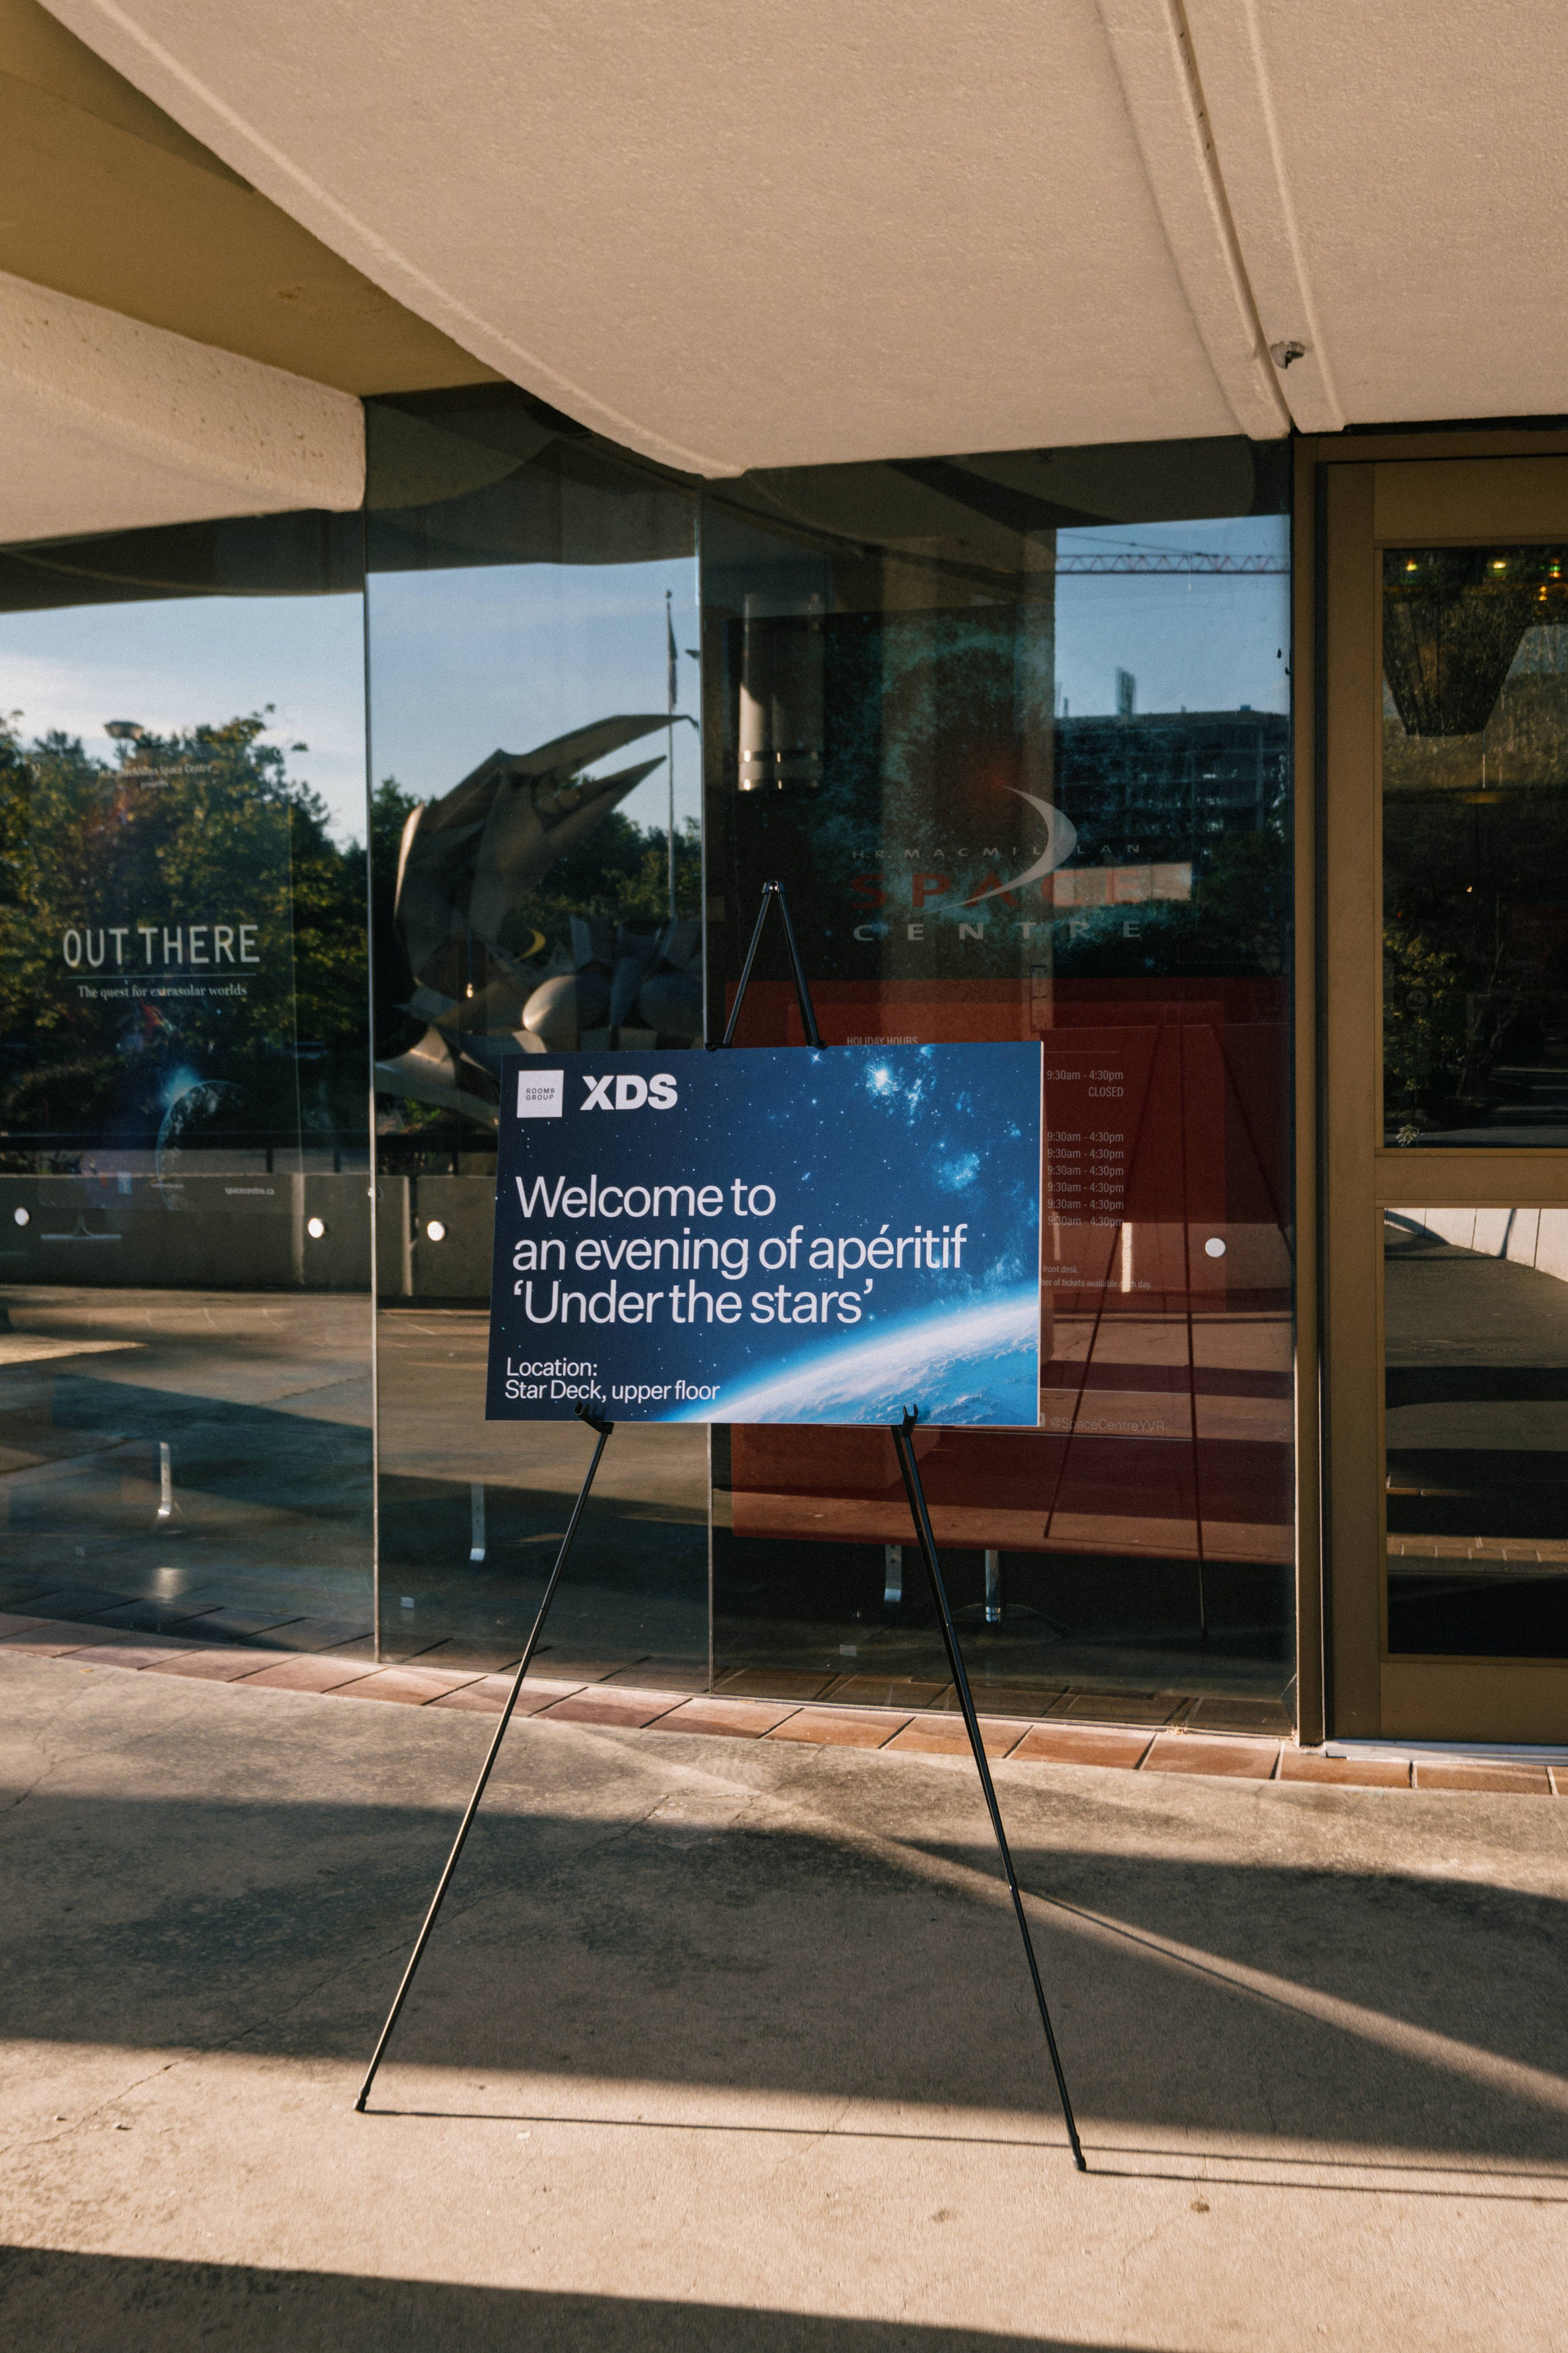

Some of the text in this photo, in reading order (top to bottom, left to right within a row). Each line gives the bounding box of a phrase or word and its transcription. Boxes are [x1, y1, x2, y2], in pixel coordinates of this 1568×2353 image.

[184, 764, 212, 774] Centre
[904, 844, 1140, 858] MACMILLAN
[851, 869, 1140, 909] SPACE
[853, 921, 1140, 942] CENTRE
[63, 924, 260, 967] OUT THERE
[77, 983, 248, 1000] The quest for extrasolar worlds
[846, 1035, 918, 1046] HOLIDAY HOURS
[1047, 1070, 1080, 1080] 9:30am
[1088, 1070, 1123, 1082] 4:30pm
[580, 1073, 678, 1111] XDS
[1088, 1087, 1123, 1097] CLOSED
[1047, 1131, 1081, 1142] 9:30am
[1089, 1132, 1124, 1144] 4:30pm
[1047, 1148, 1081, 1158] 9:30am
[1089, 1149, 1124, 1161] 4:30pm
[1047, 1165, 1081, 1176] 9:30am
[1089, 1166, 1124, 1178] 4:30pm
[1047, 1182, 1081, 1192] 9:30am
[1089, 1182, 1124, 1195] 4:30pm
[515, 1174, 776, 1218] Welcome to
[1047, 1199, 1081, 1209] 9:30am
[1089, 1199, 1124, 1212] 4:30pm
[513, 1223, 968, 1280] an evening of apéritif
[1042, 1265, 1079, 1274] front desk.
[1054, 1278, 1061, 1286] of
[1061, 1278, 1085, 1288] tickets
[1086, 1278, 1118, 1288] available
[1137, 1280, 1152, 1290] day.
[669, 1278, 742, 1323] the
[507, 1357, 598, 1377] Location:
[505, 1379, 721, 1404] Star Deck, upper floor
[1050, 1417, 1165, 1433] @SpaceCentreYVR
